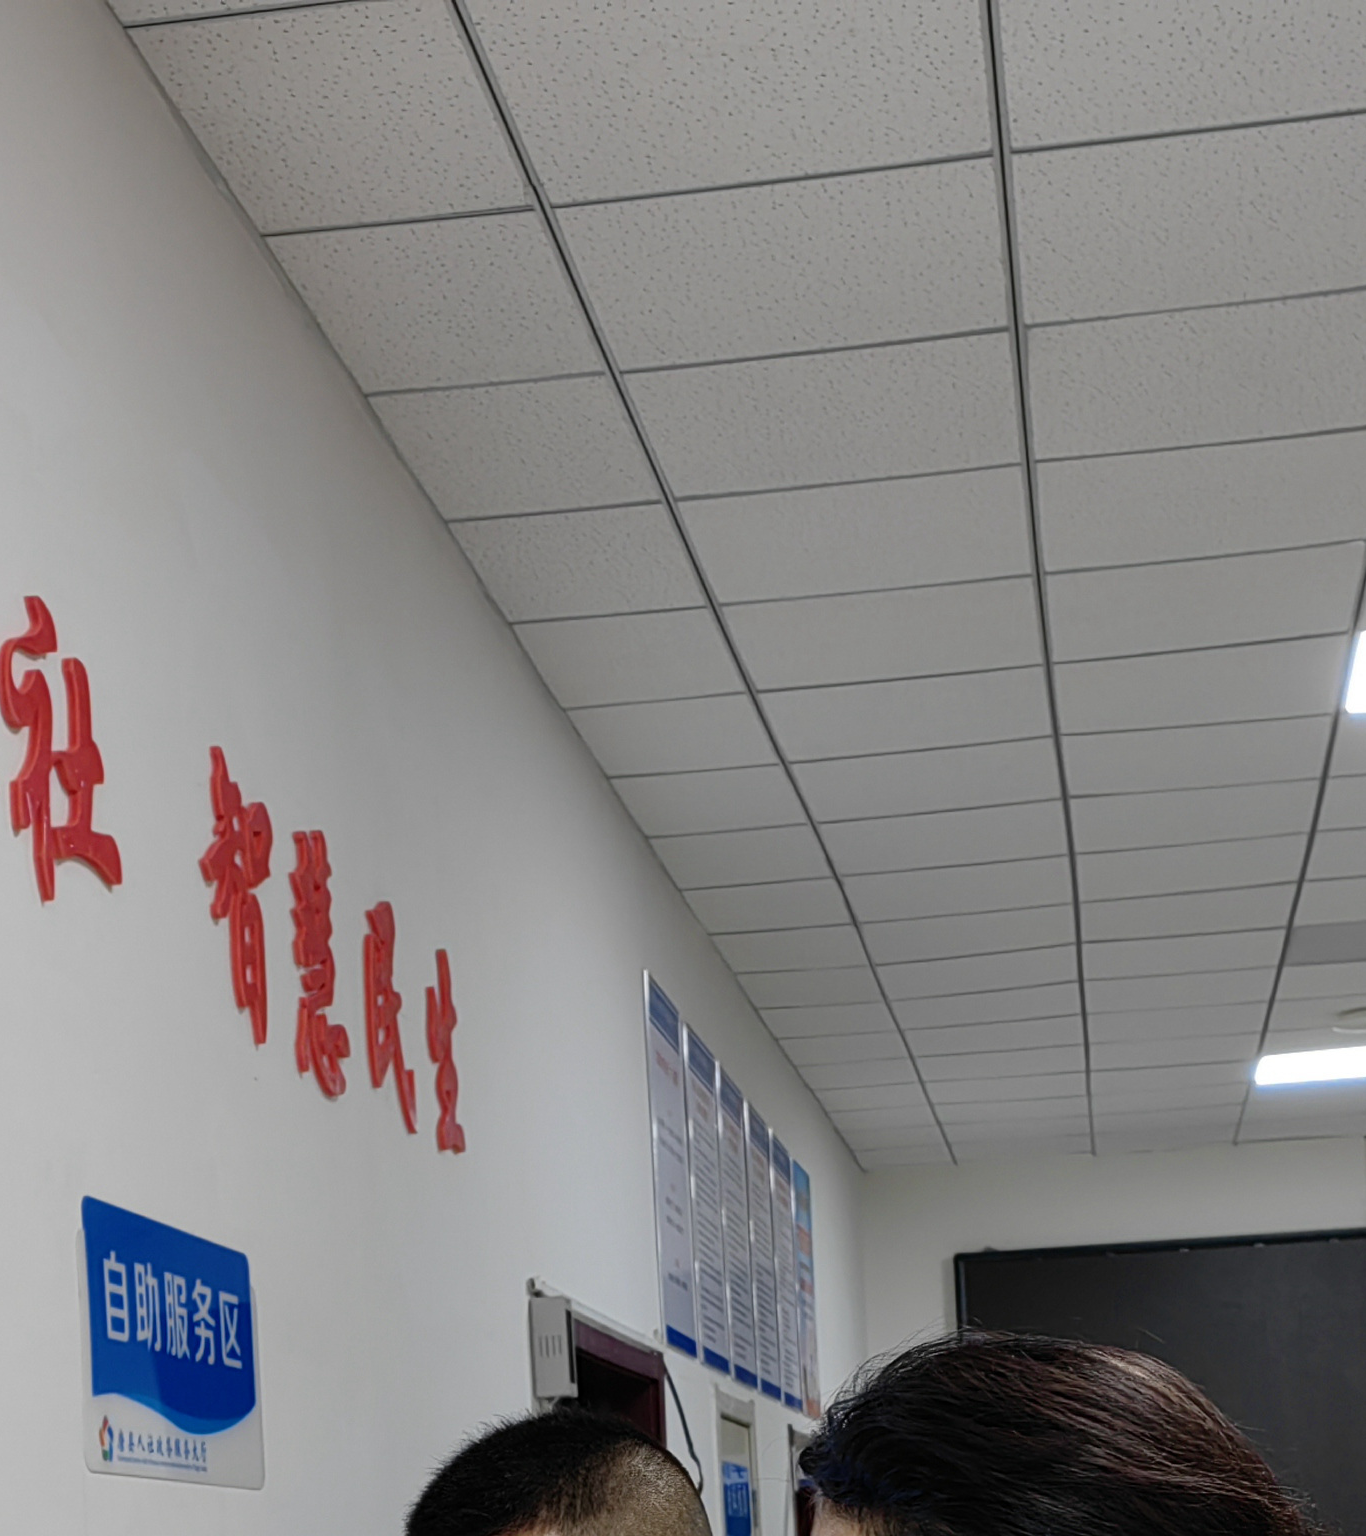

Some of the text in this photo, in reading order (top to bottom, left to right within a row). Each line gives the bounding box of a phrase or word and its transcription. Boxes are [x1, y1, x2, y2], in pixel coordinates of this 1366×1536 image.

[199, 745, 466, 1153] 智慧民生
[103, 1250, 243, 1369] 自助服务区
